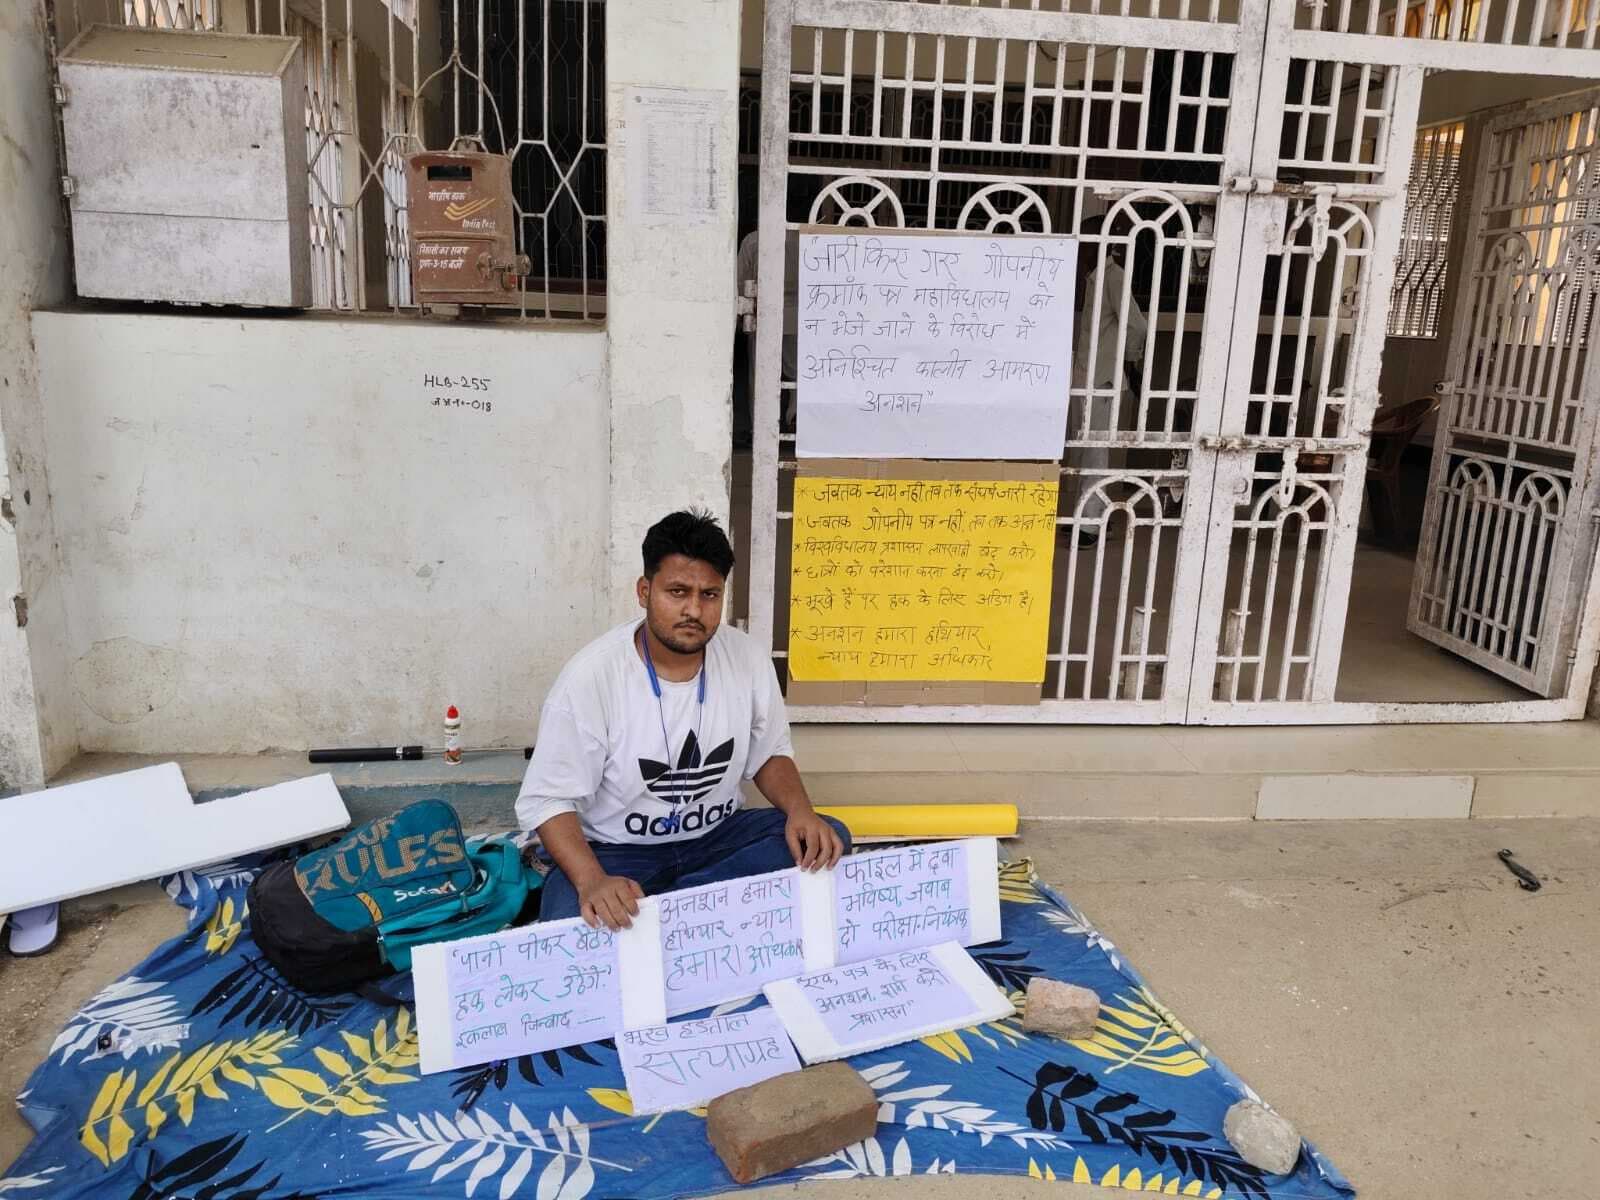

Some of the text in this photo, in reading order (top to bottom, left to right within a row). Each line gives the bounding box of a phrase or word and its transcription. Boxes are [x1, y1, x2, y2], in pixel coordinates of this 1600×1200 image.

[463, 218, 480, 229] India
[984, 242, 1064, 280] गोपनीय
[1029, 281, 1054, 309] को
[804, 318, 827, 336] न
[872, 311, 916, 339] जाने
[928, 312, 944, 338] के
[1016, 315, 1036, 340] में
[916, 348, 972, 380] कालीन
[982, 359, 1051, 386] आमरण
[424, 373, 491, 391] HLB-255
[997, 483, 1026, 504] जारी
[863, 507, 913, 531] गोपनीय
[845, 559, 864, 577] को
[857, 594, 880, 610] पर
[888, 594, 912, 610] हक
[917, 588, 932, 606] के
[805, 625, 867, 644] अनशन
[875, 626, 918, 645] हमारा
[817, 646, 992, 671] न्याय हमारा अधिकार
[624, 798, 734, 836] adidas
[843, 854, 902, 882] फाइल
[909, 848, 925, 871] में
[393, 880, 457, 902] Safari
[660, 876, 792, 923] अनशन हमारा
[740, 905, 793, 930] न्याय
[518, 932, 575, 960] पीकर
[838, 918, 861, 948] दो
[666, 943, 742, 991] हमारा
[455, 989, 485, 1021] हक
[495, 974, 551, 1008] लेकर
[633, 1036, 783, 1086] सत्याग्रह
